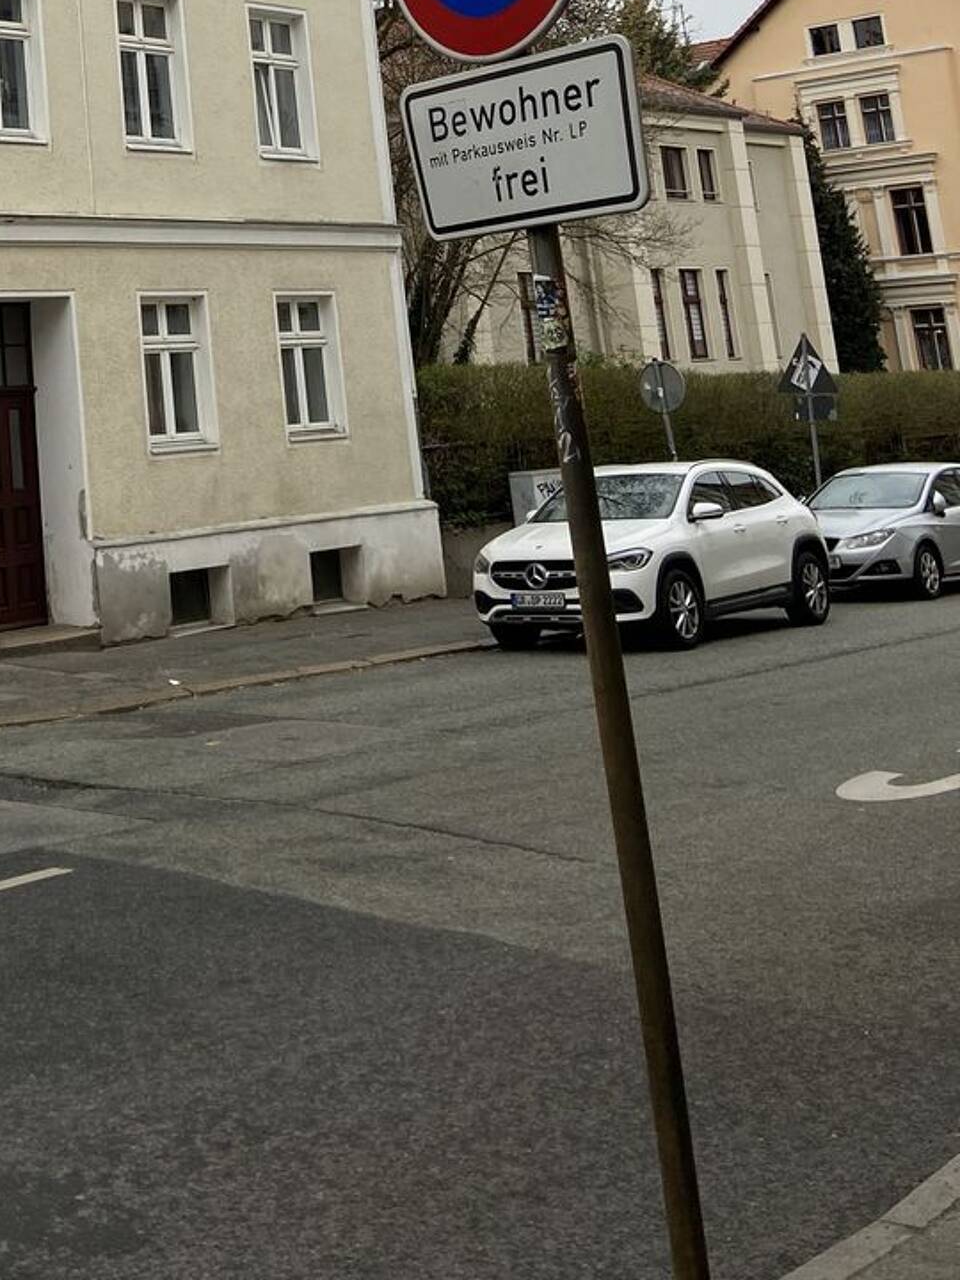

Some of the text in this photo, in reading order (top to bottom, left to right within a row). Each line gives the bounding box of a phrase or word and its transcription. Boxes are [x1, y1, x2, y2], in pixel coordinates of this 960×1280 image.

[428, 78, 600, 142] Bewohner
[429, 120, 587, 168] mit Parkausweis Nr. LP
[492, 156, 550, 202] frei
